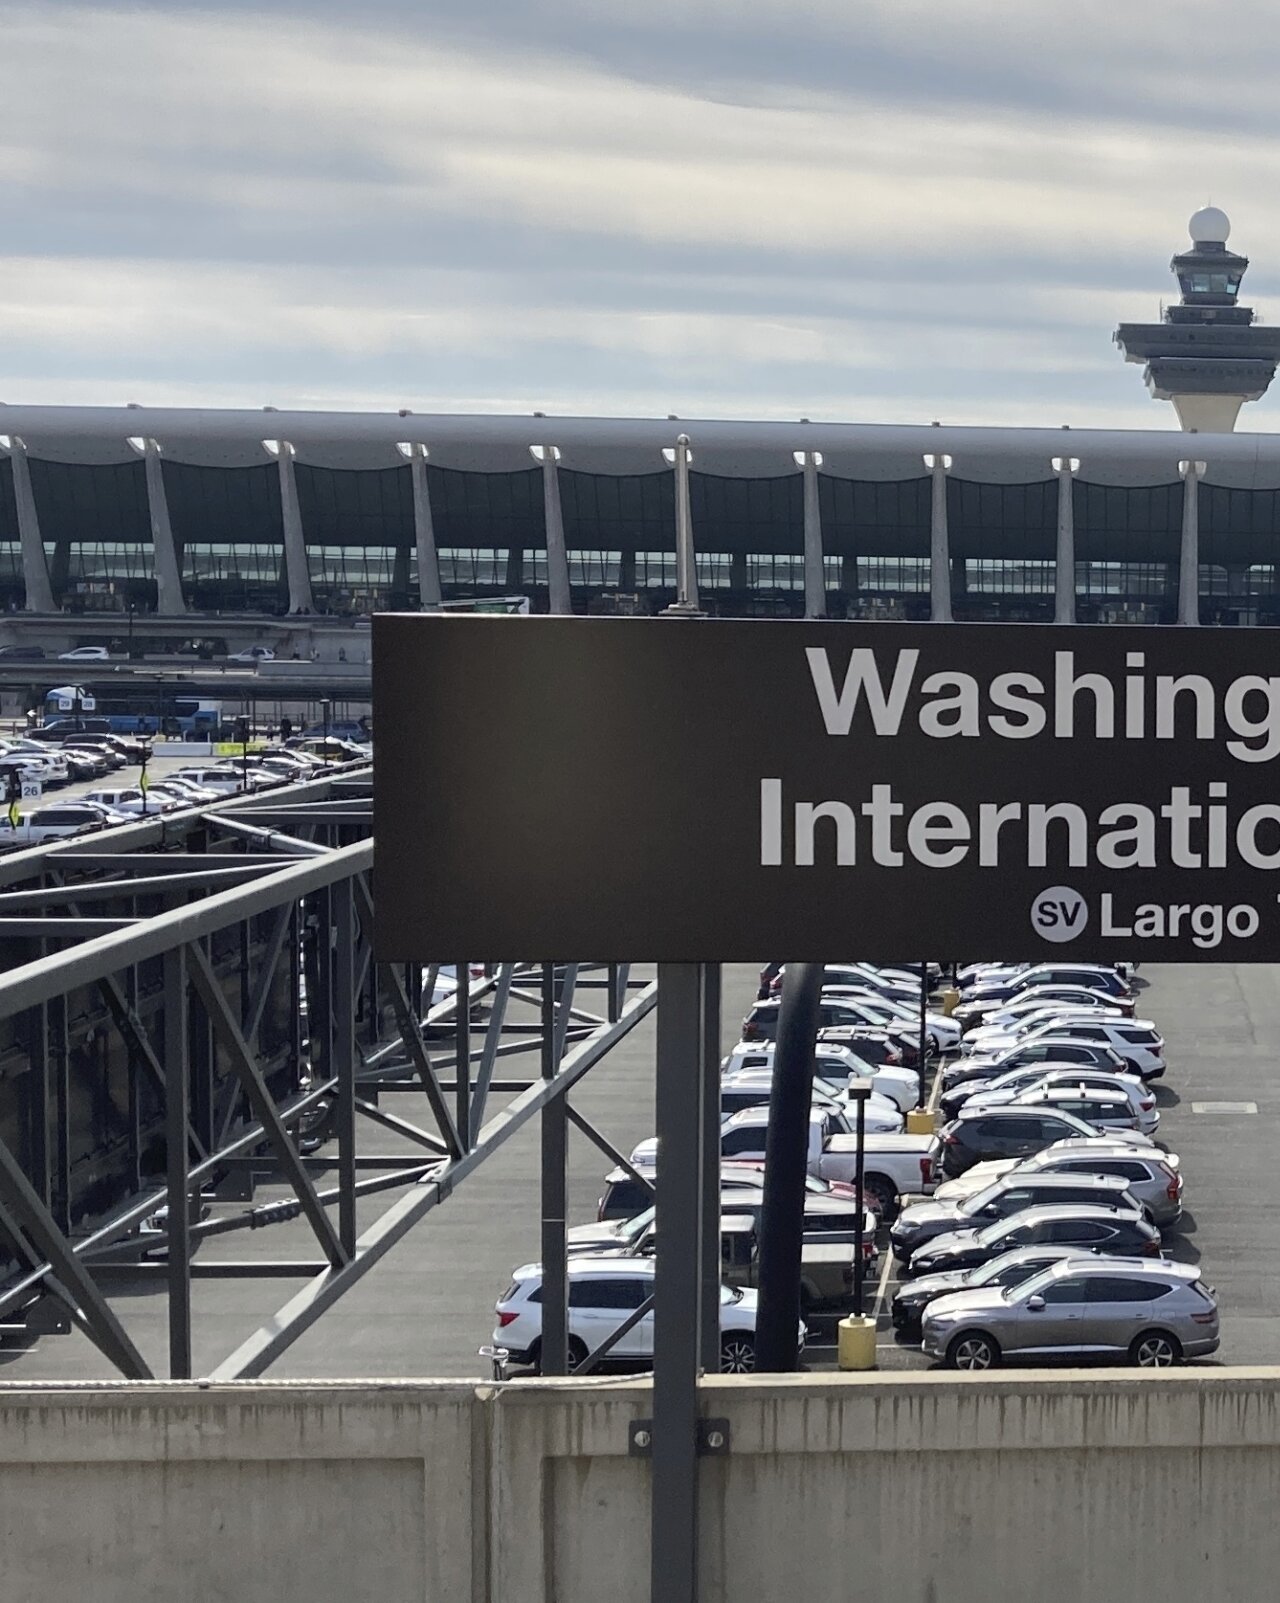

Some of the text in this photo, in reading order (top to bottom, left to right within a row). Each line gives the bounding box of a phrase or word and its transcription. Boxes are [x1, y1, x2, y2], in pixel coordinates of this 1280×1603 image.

[23, 786, 38, 796] 26
[1037, 901, 1082, 928] SV
[1101, 893, 1260, 948] Largo
